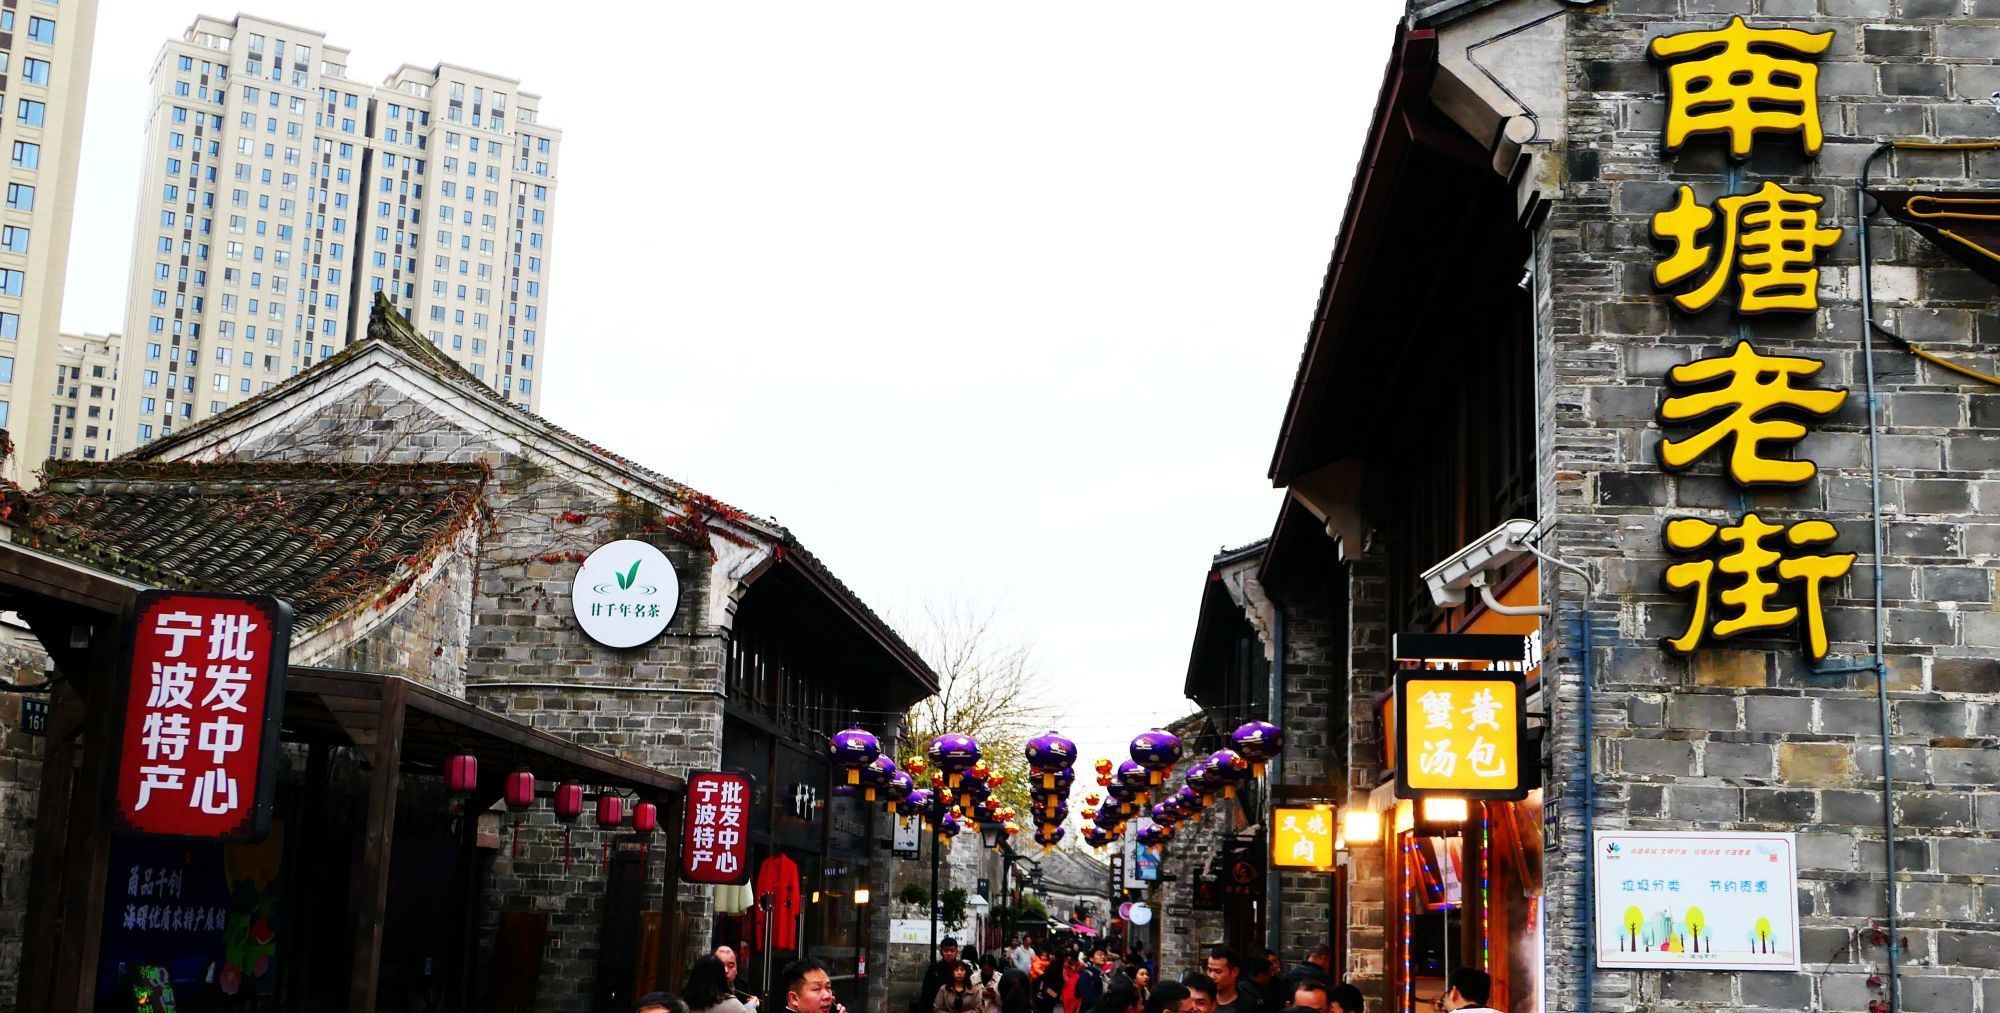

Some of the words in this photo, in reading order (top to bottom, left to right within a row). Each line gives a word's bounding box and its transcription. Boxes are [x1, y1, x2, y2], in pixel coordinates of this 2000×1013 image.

[1648, 15, 1858, 662] 南塘老街
[29, 715, 44, 731] 161
[134, 610, 203, 812] 宁波特产
[189, 613, 258, 815] 批发中心
[1417, 687, 1504, 732] 蟹黄
[1419, 735, 1507, 778] 汤包
[691, 780, 719, 872] 宁波特产
[715, 781, 743, 873] 批发中心
[1280, 813, 1328, 836] 叉烧
[1293, 834, 1316, 863] 肉
[1621, 878, 1681, 893] 垃圾分类
[1709, 879, 1769, 893] 节约资源
